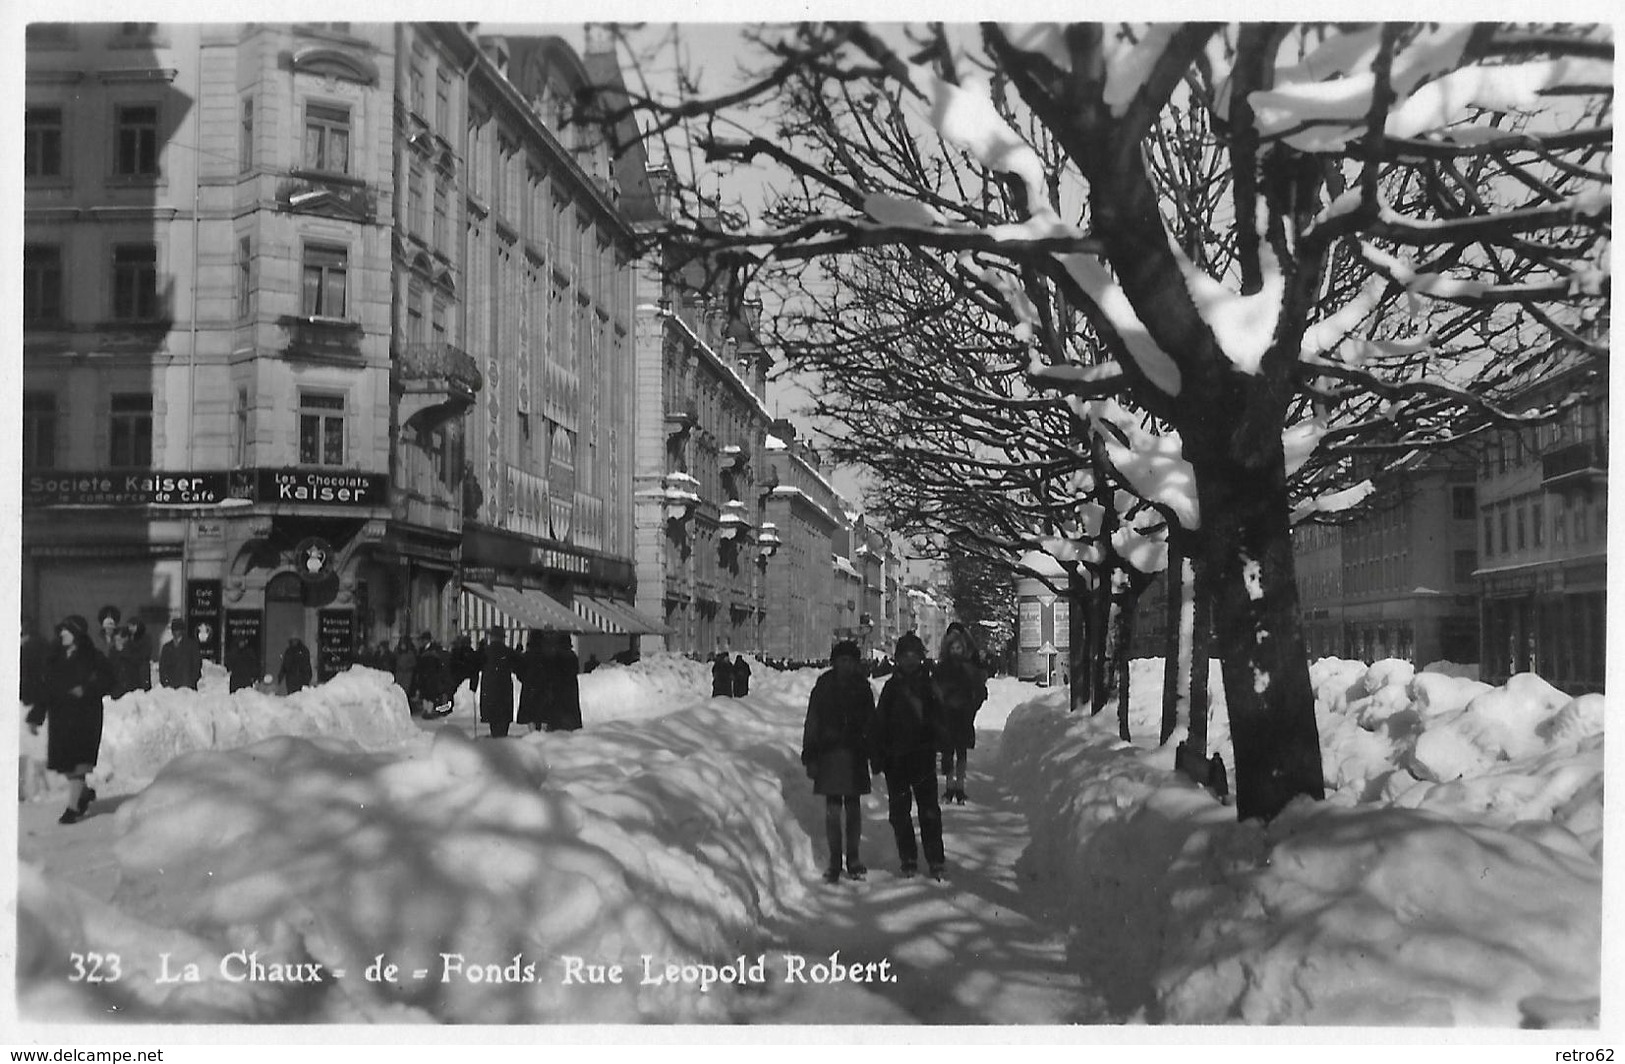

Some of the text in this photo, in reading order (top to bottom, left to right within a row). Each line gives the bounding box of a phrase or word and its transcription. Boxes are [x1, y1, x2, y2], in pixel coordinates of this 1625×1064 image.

[125, 474, 203, 492] Kaiser
[275, 472, 369, 487] Les Chocolats
[155, 490, 171, 502] de
[279, 483, 366, 502] Kaiser
